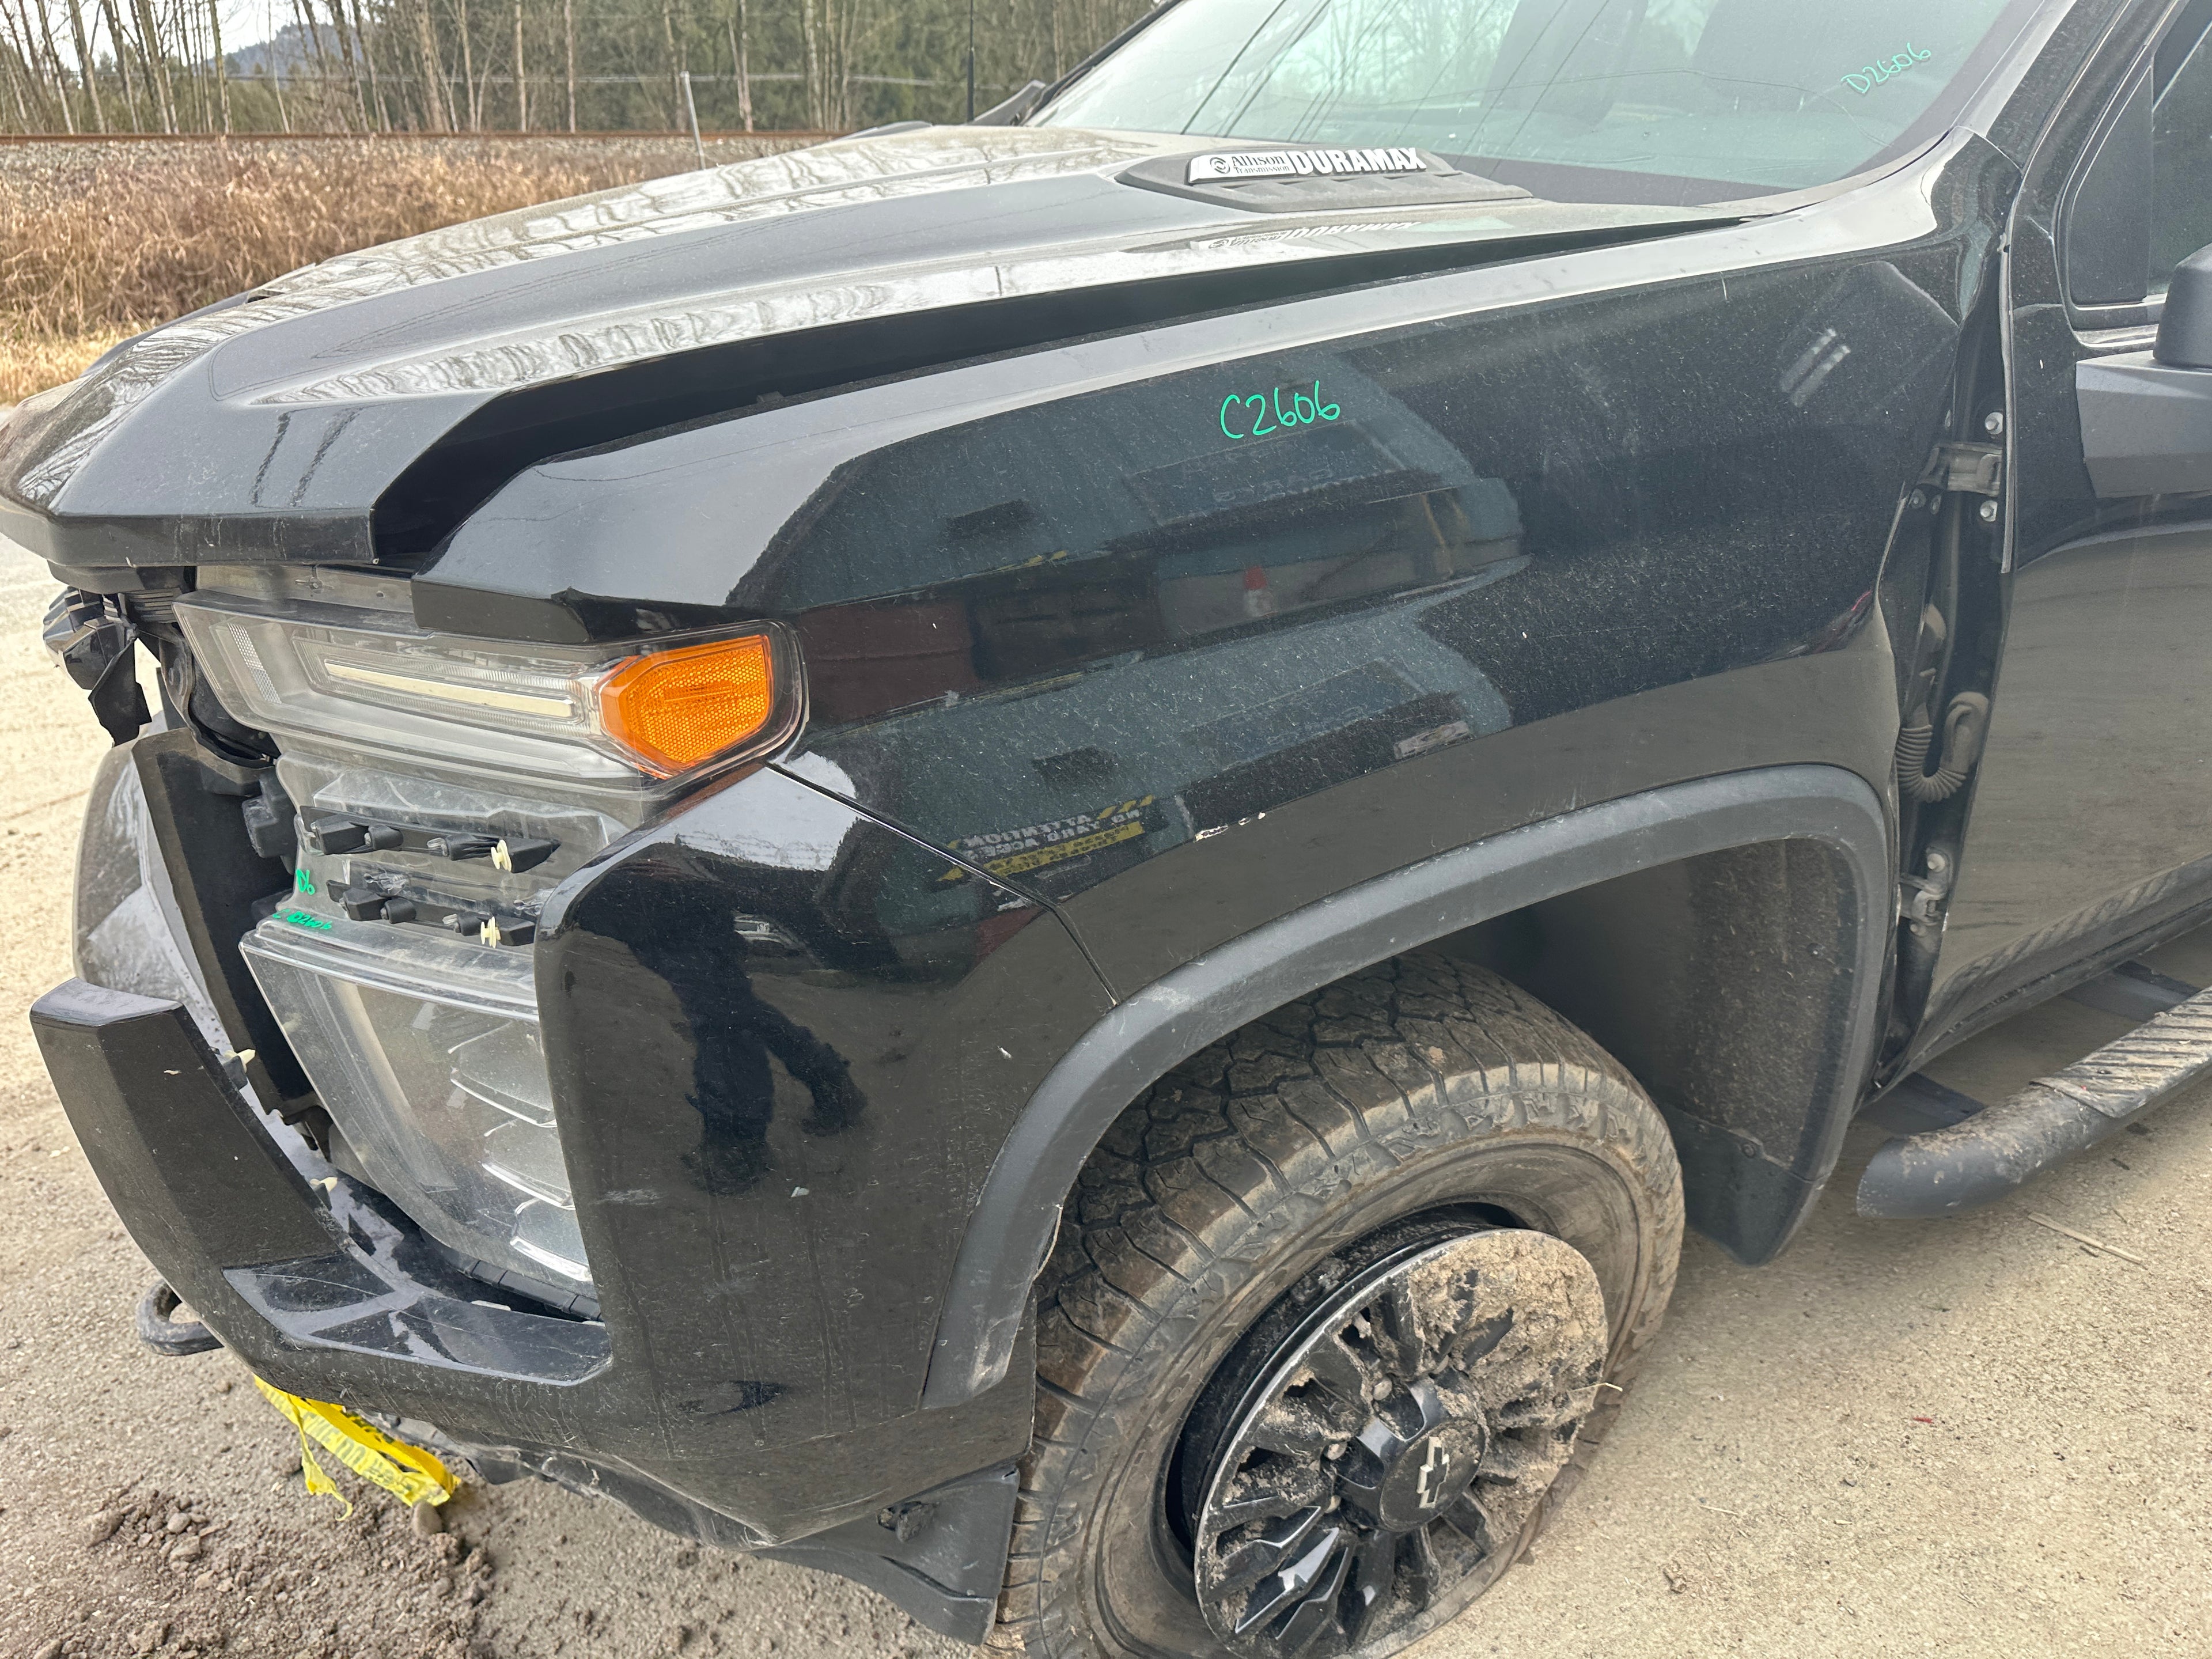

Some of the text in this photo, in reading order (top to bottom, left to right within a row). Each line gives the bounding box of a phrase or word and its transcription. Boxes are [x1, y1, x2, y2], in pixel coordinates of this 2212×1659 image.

[1840, 42, 1931, 93] D2606
[1231, 155, 1286, 167] Allison
[1233, 165, 1290, 174] Transmission
[1286, 147, 1427, 175] DURAMAX
[1219, 380, 1340, 439] C2606
